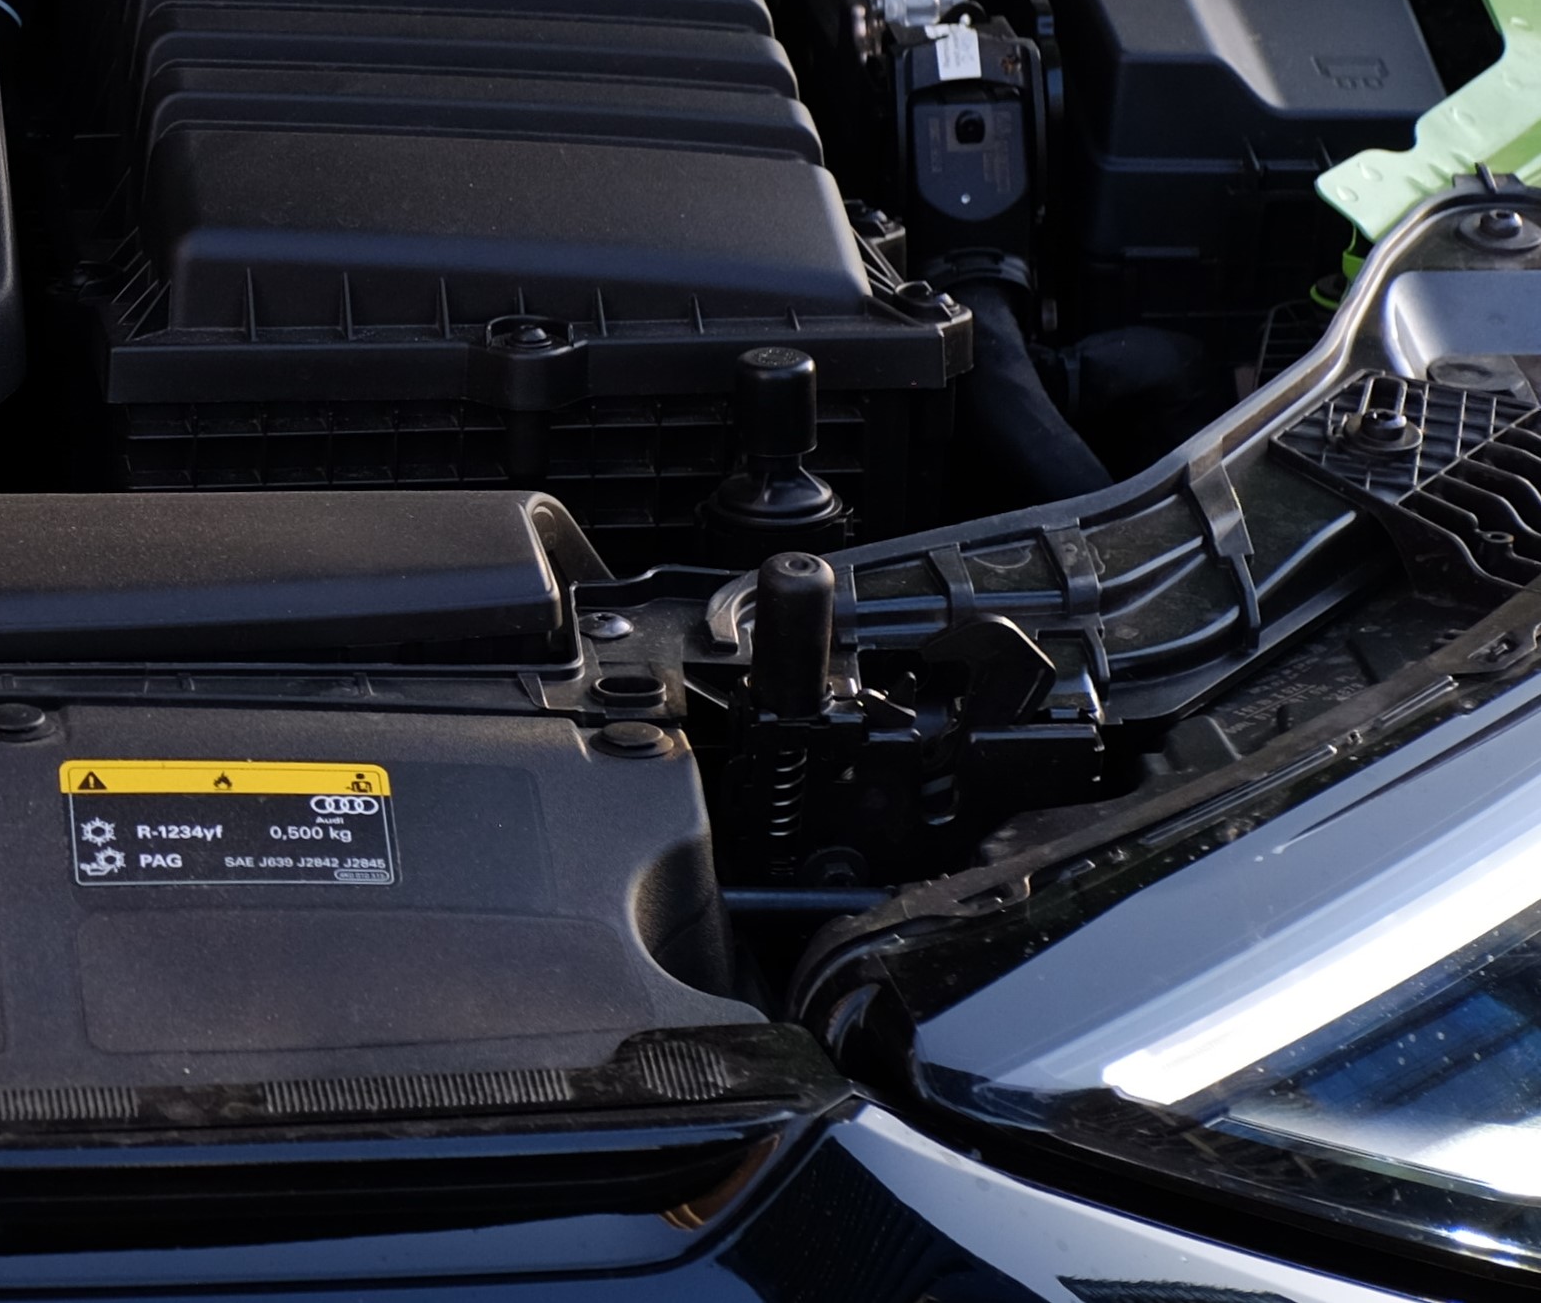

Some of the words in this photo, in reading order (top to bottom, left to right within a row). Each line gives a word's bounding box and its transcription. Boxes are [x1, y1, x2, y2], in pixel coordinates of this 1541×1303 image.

[316, 816, 344, 825] Audi
[136, 824, 223, 841] R-1234yf
[269, 825, 324, 841] 0,500
[329, 825, 353, 843] kg
[139, 852, 183, 868] PAG
[224, 856, 255, 868] SAE
[259, 856, 294, 868] J639
[297, 856, 340, 869] J2842
[343, 857, 387, 870] J2845
